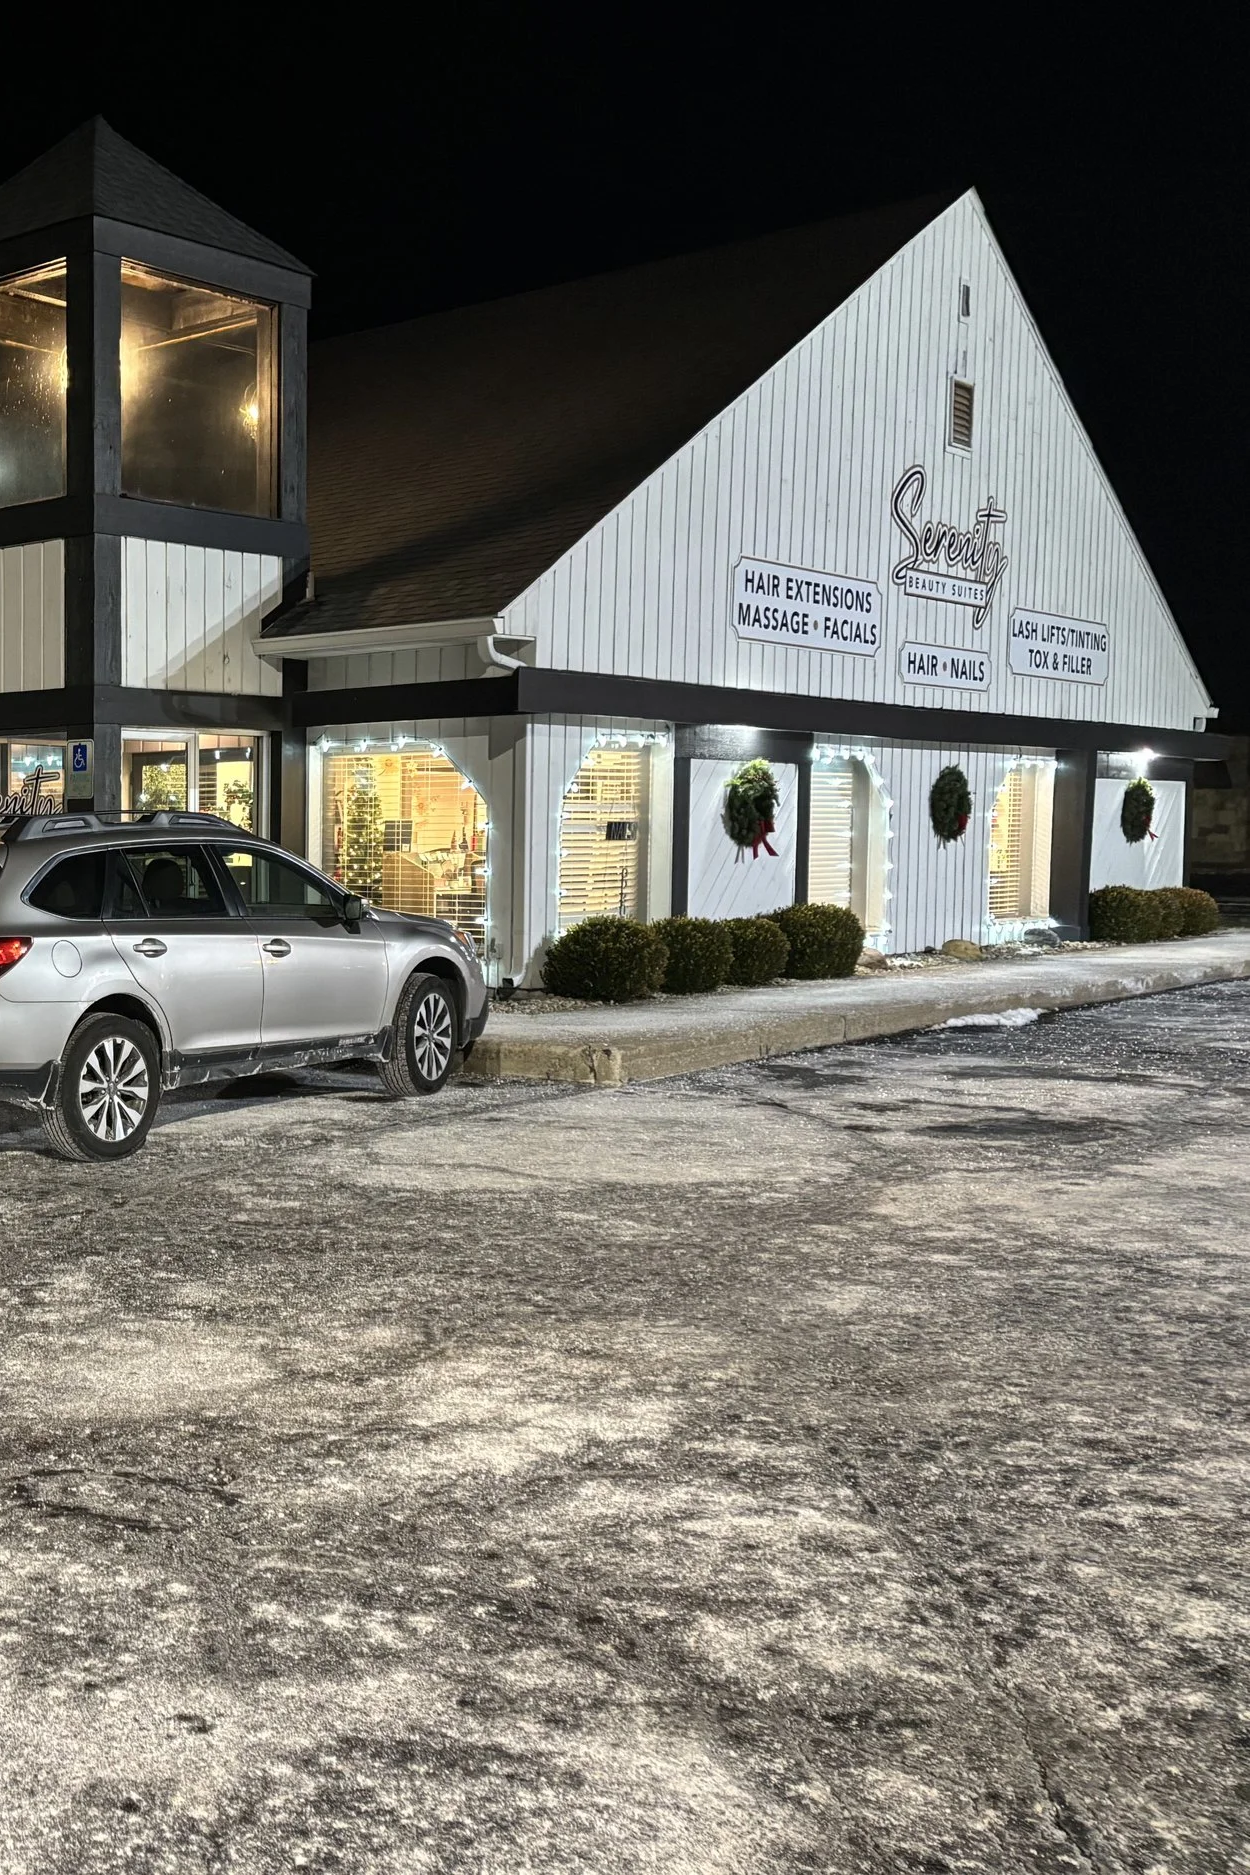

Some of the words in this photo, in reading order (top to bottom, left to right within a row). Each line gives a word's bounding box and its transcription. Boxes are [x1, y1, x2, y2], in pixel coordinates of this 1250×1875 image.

[891, 464, 1008, 630] Serenity
[744, 569, 780, 598] HAIR
[786, 577, 872, 613] EXTENSIONS
[908, 575, 947, 595] BEAUTY
[951, 583, 985, 601] SUITES
[738, 602, 809, 635] MASSAGE
[824, 616, 877, 645] FACIALS
[1012, 618, 1038, 641] LASH
[1041, 623, 1107, 652] LIFTS/TINTING
[907, 652, 938, 677] HAIR
[950, 657, 985, 682] NAILS
[1028, 648, 1049, 670] TOX
[1052, 652, 1060, 671] &
[1062, 653, 1092, 676] FILLER
